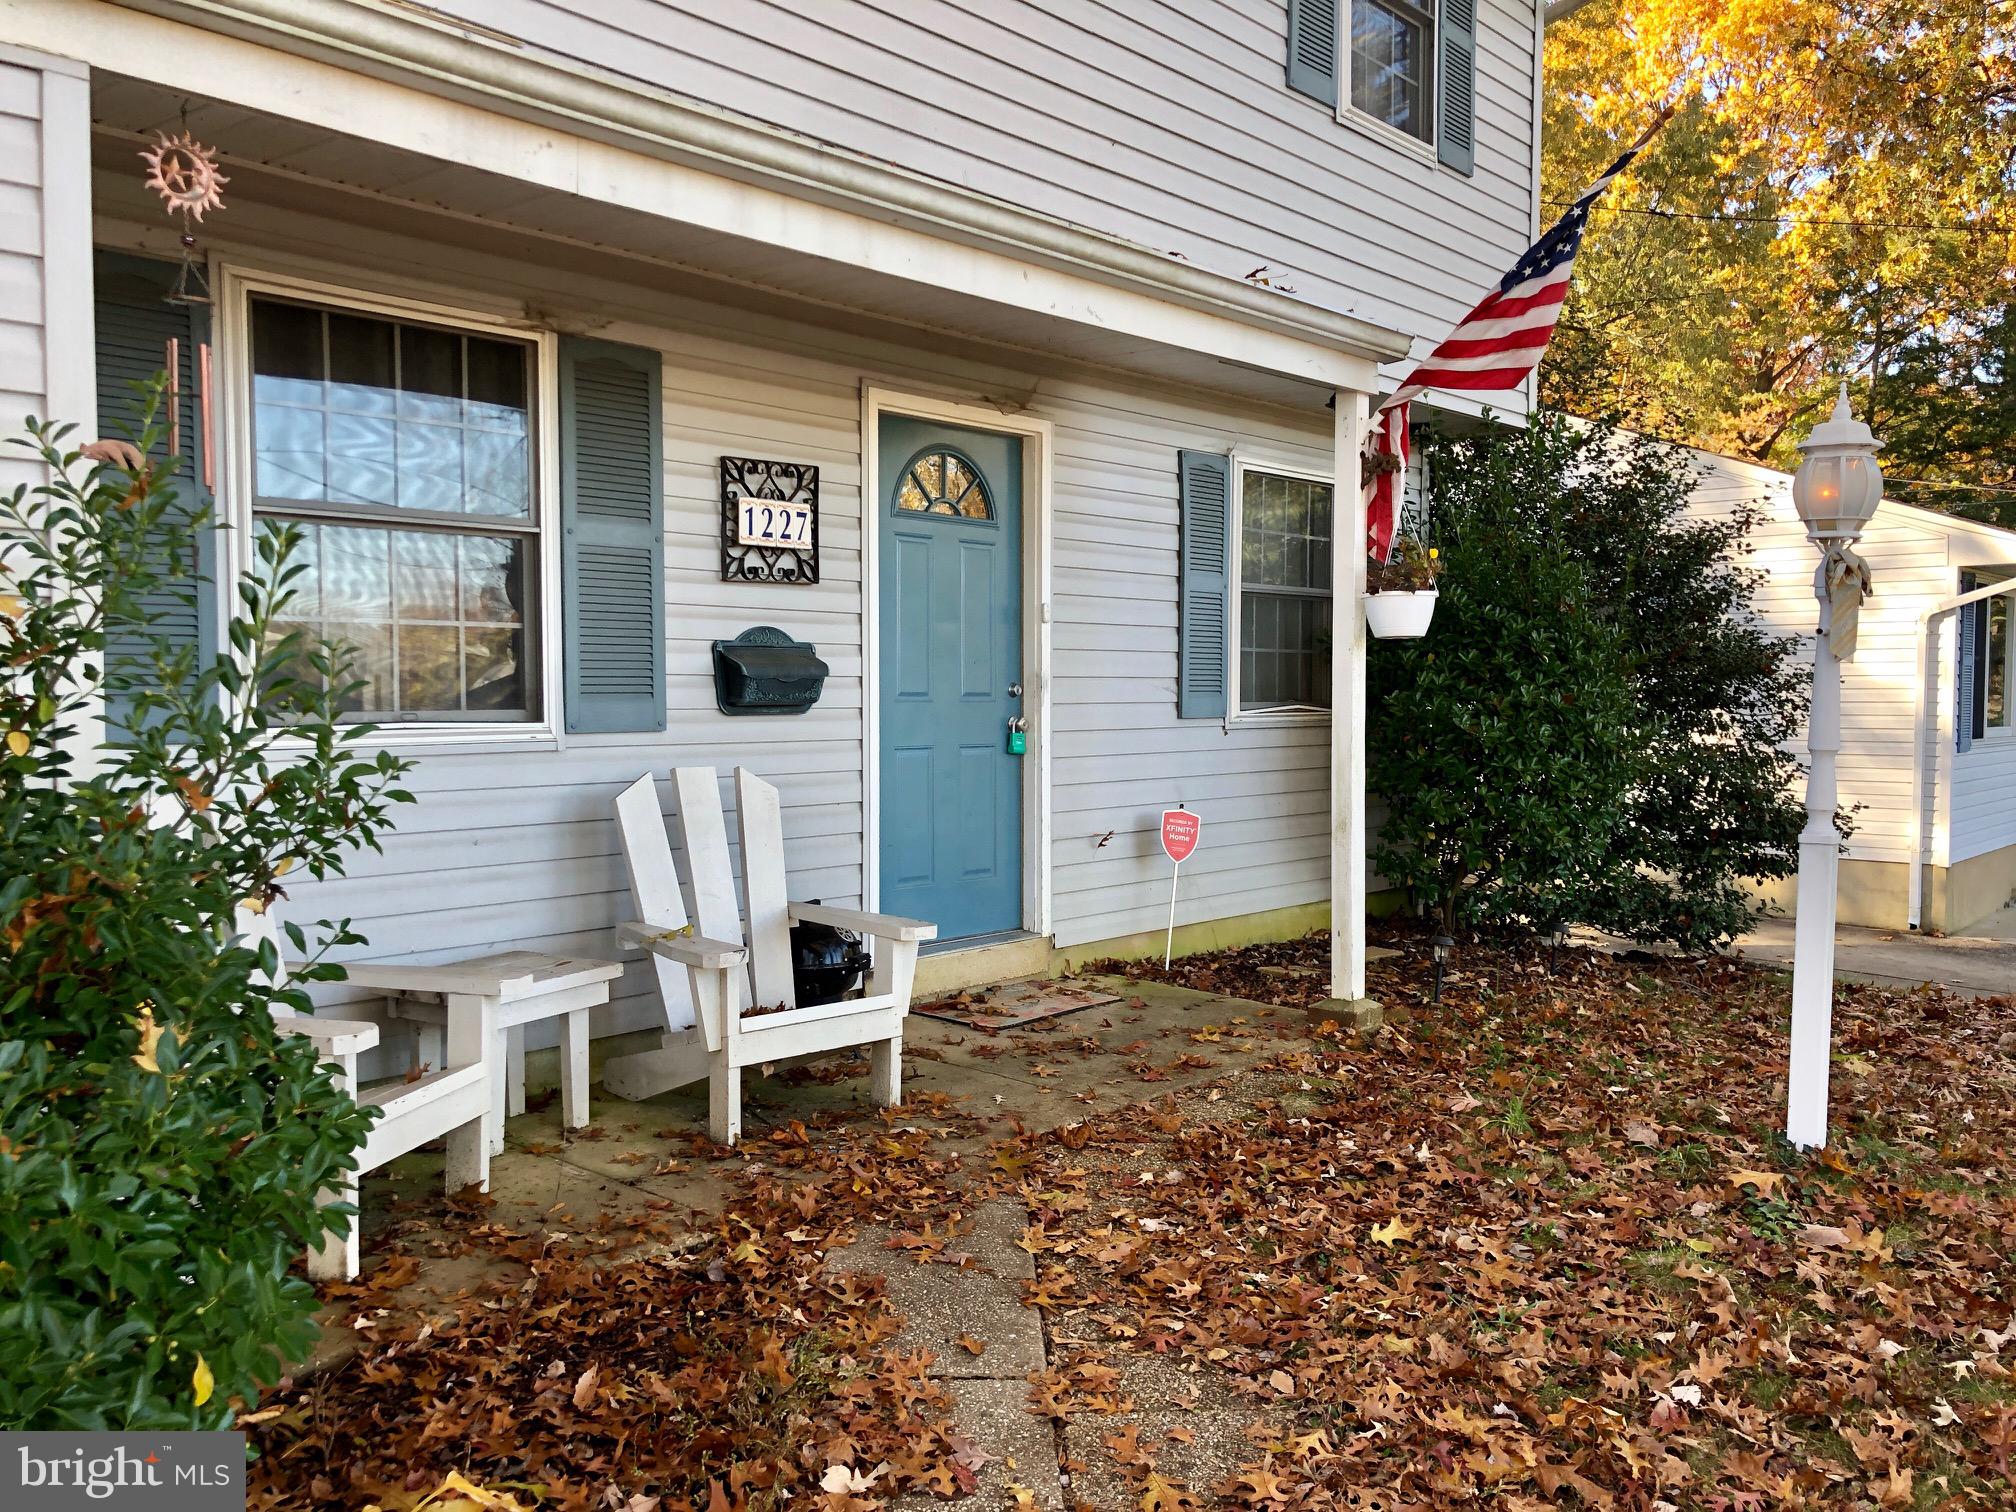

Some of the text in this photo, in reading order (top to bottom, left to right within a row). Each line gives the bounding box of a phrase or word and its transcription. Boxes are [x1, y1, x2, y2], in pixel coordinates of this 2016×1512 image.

[745, 506, 808, 541] 1227
[1166, 824, 1195, 834] XFINITY
[1169, 833, 1189, 842] Home
